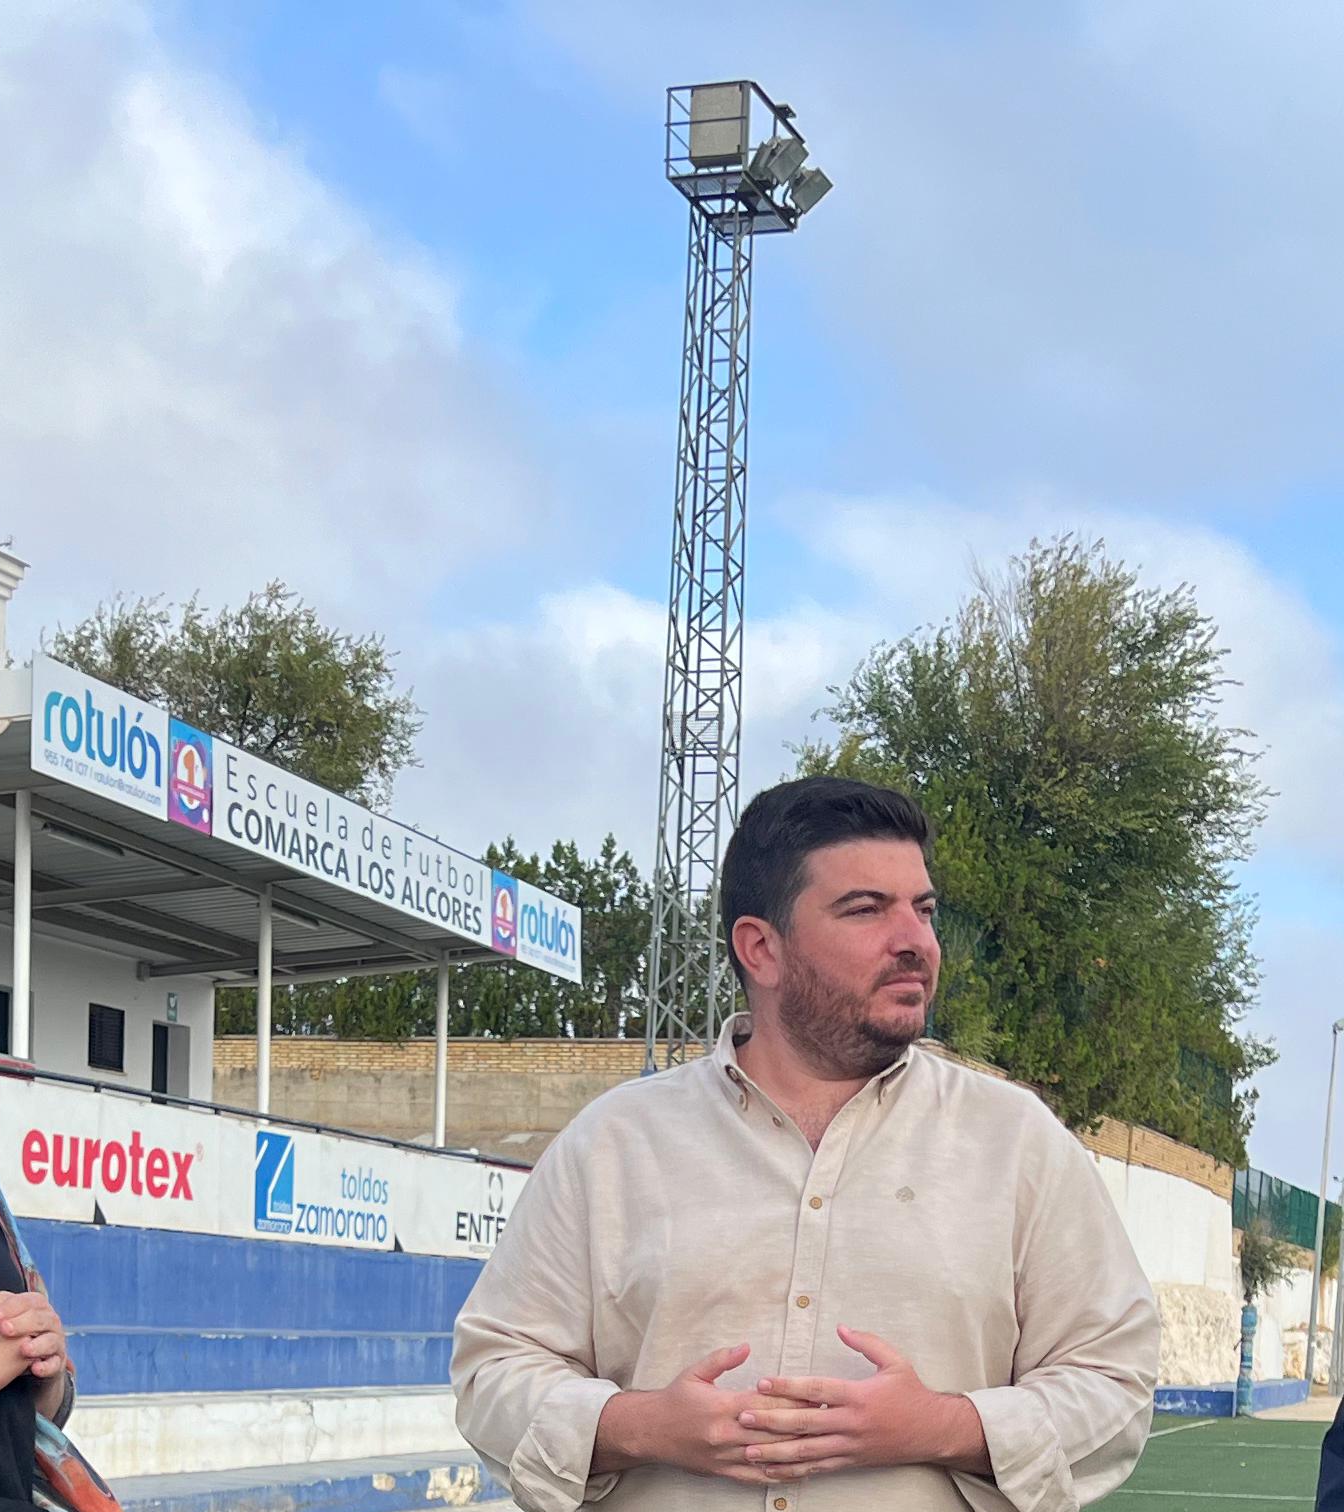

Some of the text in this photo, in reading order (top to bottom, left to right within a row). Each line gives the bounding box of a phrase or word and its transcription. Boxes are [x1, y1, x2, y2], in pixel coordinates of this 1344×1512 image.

[44, 689, 162, 788] rotulón
[226, 753, 484, 901] Escuela de Futbol
[227, 801, 482, 936] COMARCA LOS ALCORES
[520, 899, 576, 960] rotulón
[295, 1203, 387, 1243] zamorano
[341, 1166, 389, 1205] toldos
